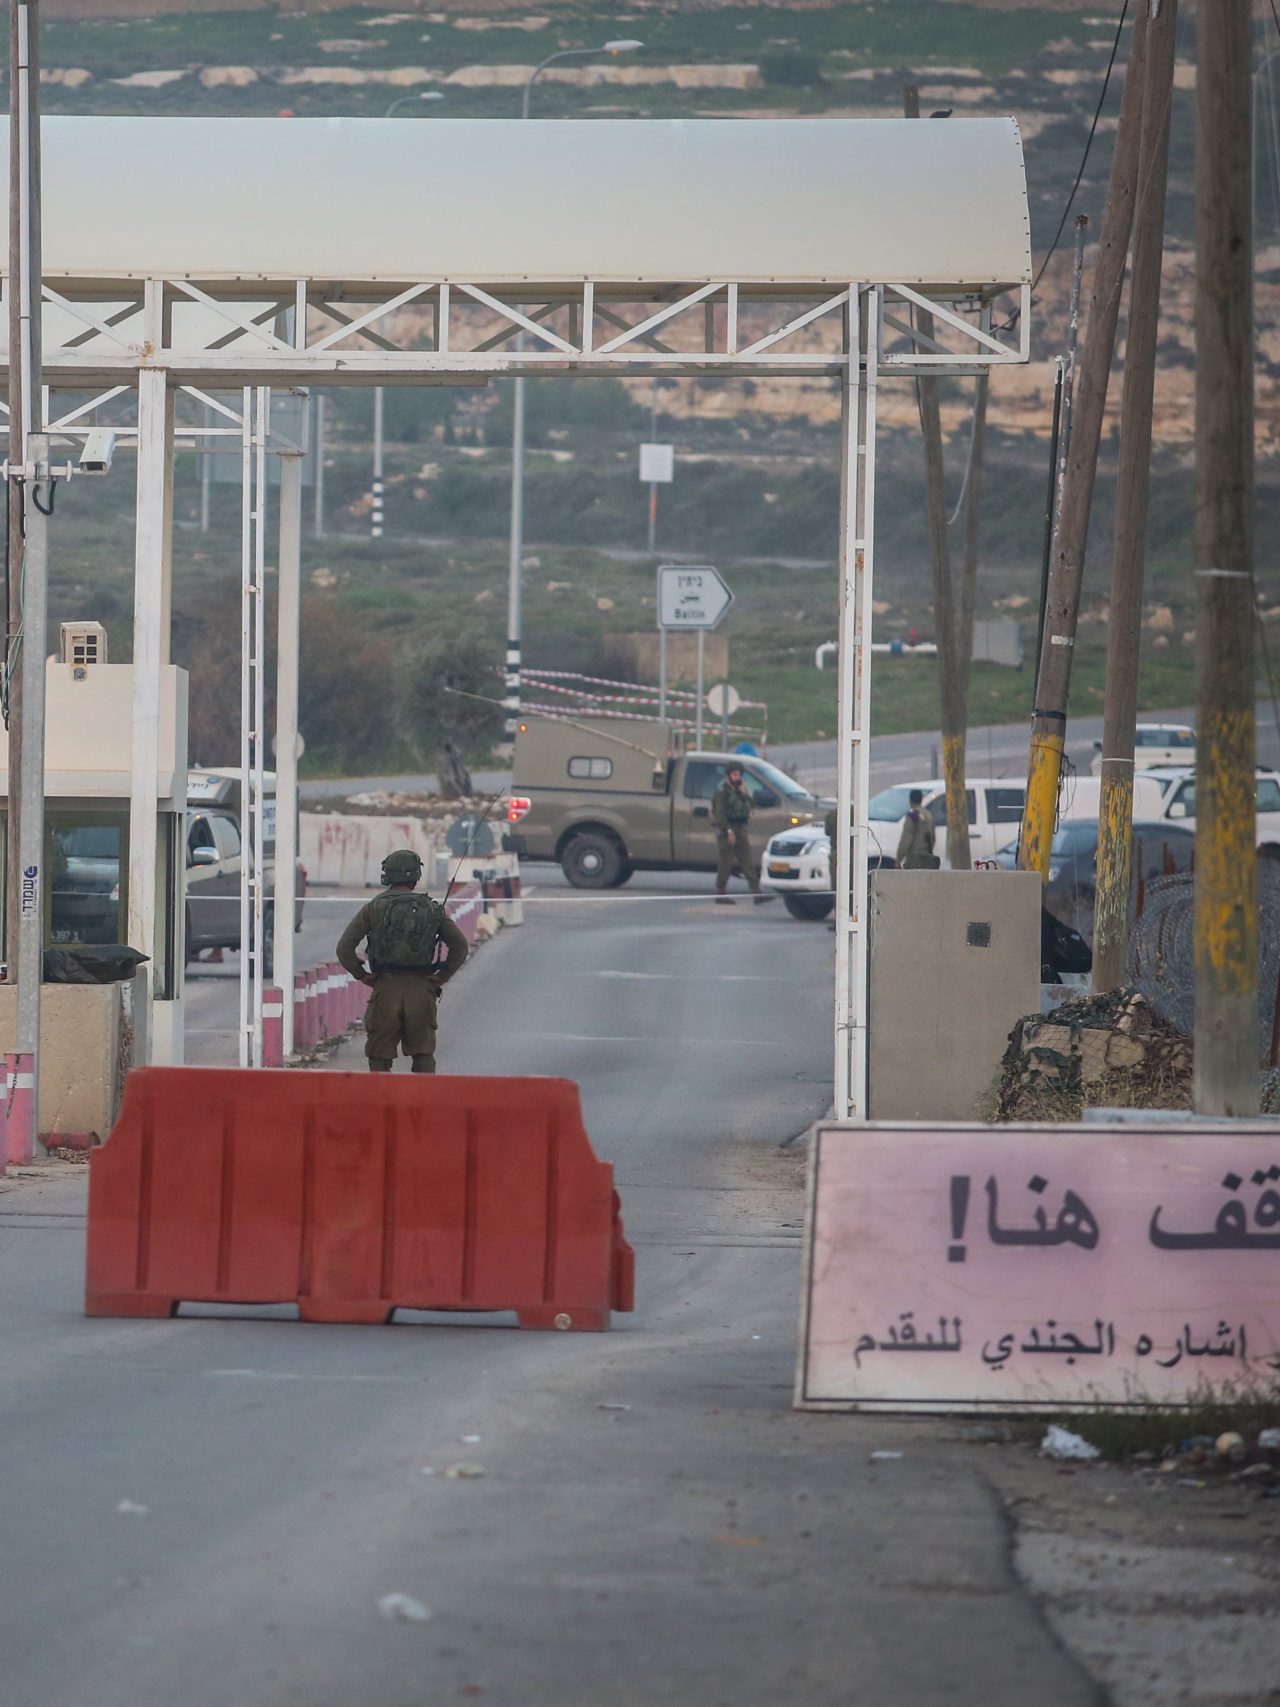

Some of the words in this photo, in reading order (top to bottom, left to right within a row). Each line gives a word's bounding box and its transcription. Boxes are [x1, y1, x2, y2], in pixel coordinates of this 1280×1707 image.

[22, 879, 34, 912] שמרד
[947, 1174, 1100, 1262] هنا!
[981, 1317, 1115, 1370] الجندي
